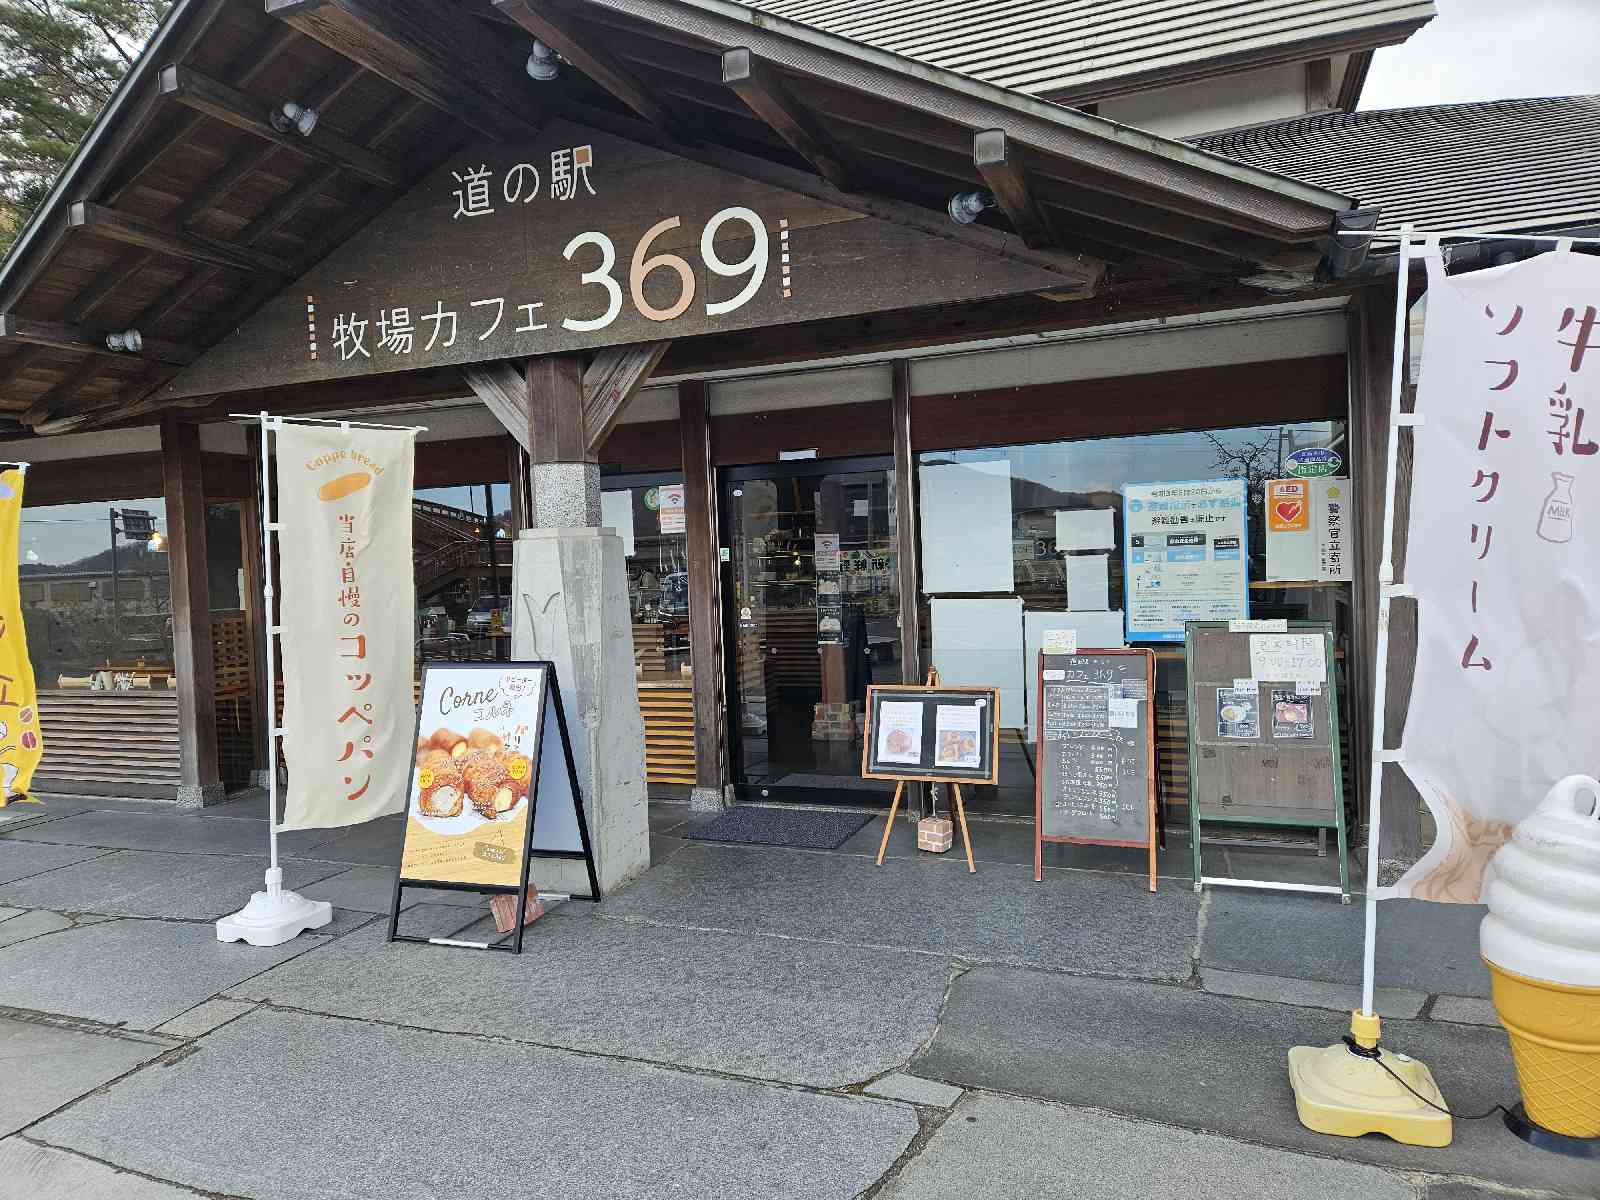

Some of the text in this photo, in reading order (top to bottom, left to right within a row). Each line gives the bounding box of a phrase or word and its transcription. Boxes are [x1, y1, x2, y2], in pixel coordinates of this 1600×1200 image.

[451, 144, 597, 219] 道の駅
[331, 206, 769, 361] 牧場カフェ 369
[1547, 305, 1600, 456] 牛乳
[1279, 485, 1298, 493] AED
[1461, 303, 1524, 671] ソフトクリーム
[1328, 502, 1341, 575] 警察官立寄所
[440, 686, 499, 716] Corne
